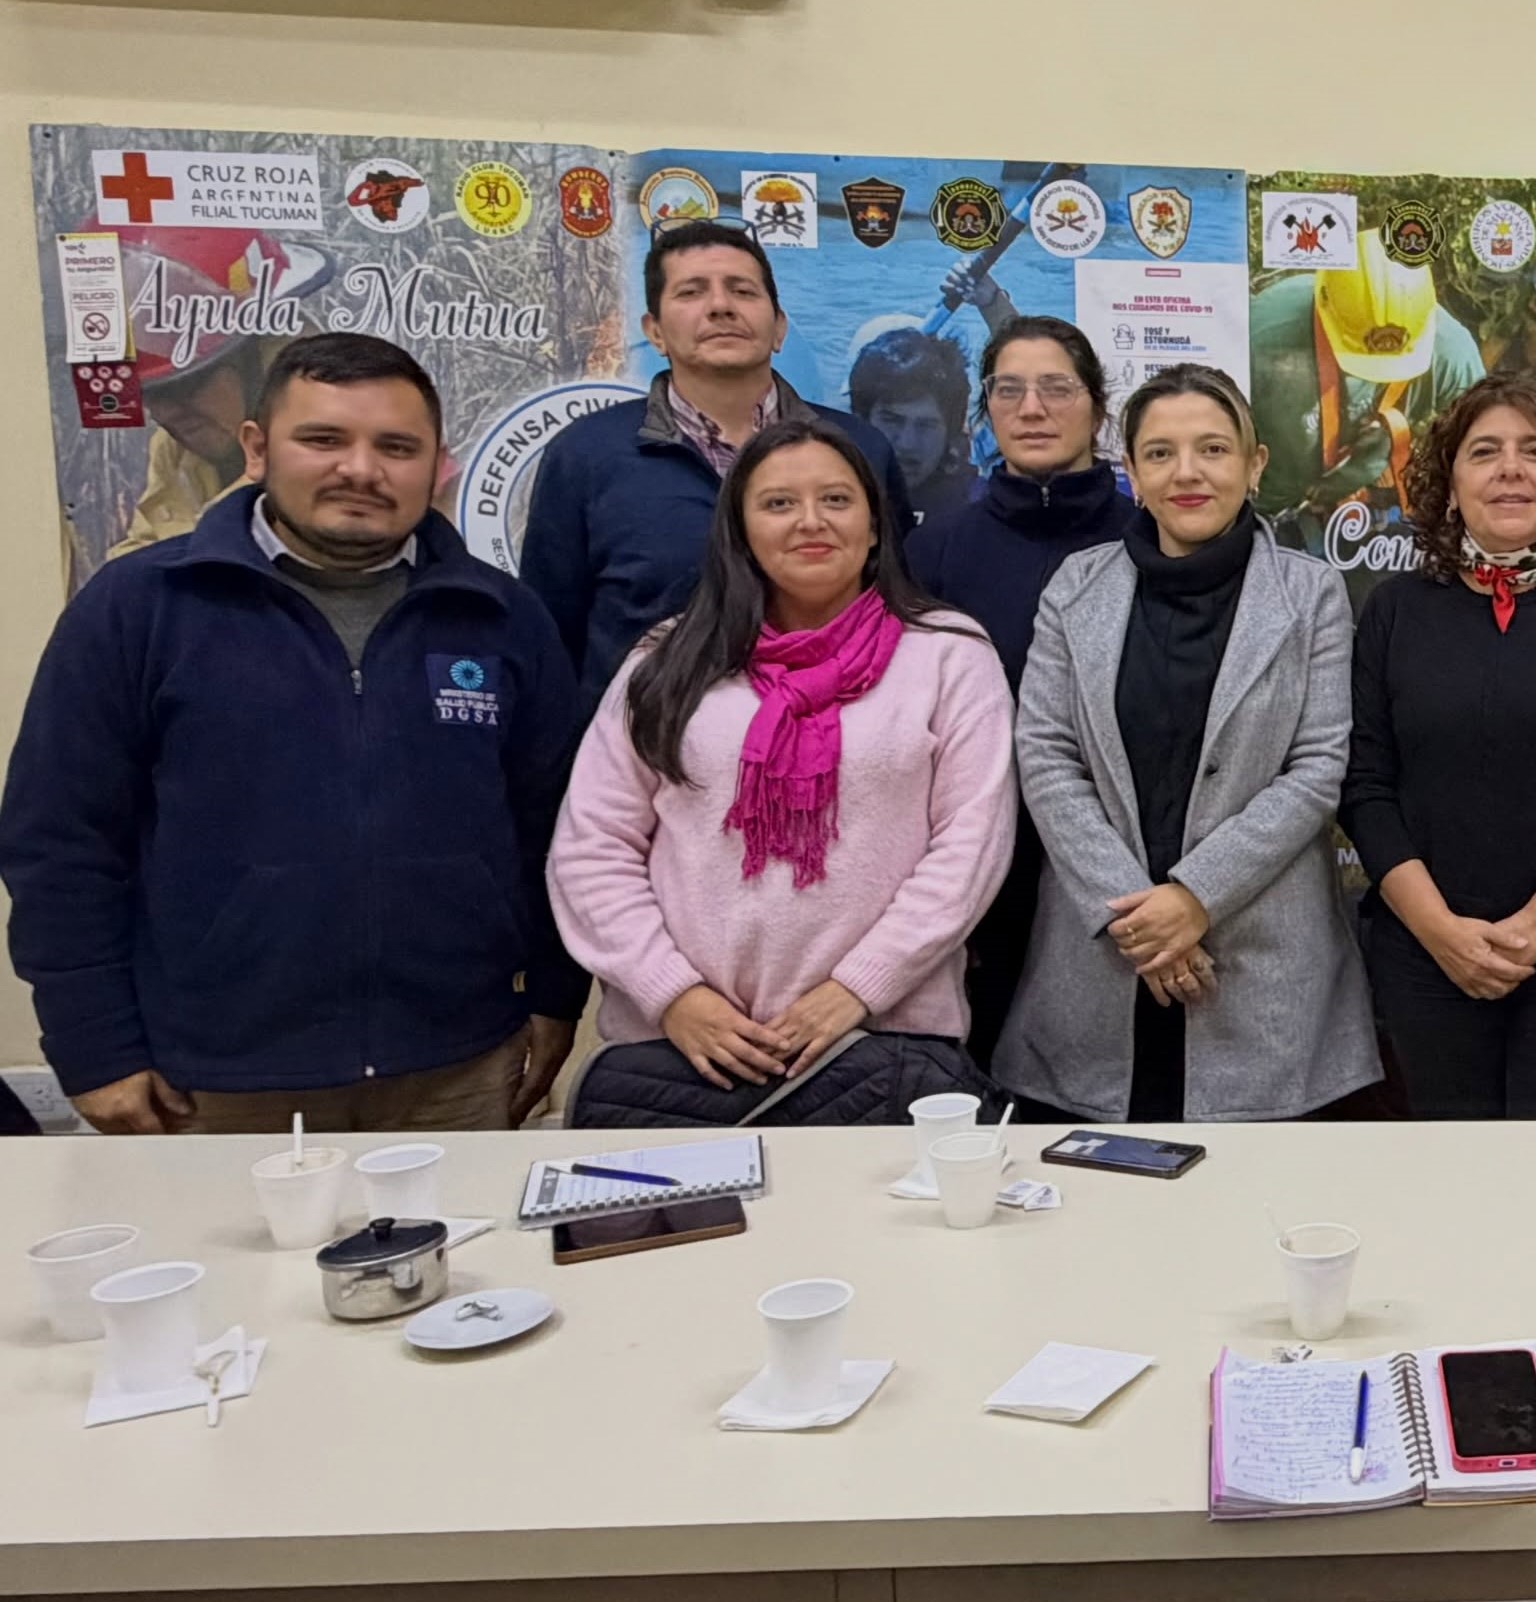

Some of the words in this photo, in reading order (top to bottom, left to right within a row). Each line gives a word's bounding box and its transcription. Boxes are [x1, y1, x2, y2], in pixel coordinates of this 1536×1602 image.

[187, 164, 245, 183] CRUZ
[255, 166, 313, 185] ROJA
[471, 163, 495, 174] CLUB
[191, 188, 315, 204] ARGENTINA
[191, 204, 237, 219] FILIAL
[240, 206, 317, 220] TUCUMAN
[130, 259, 302, 366] Ayuda
[330, 264, 547, 340] Mutua
[478, 410, 562, 517] DEFENSA
